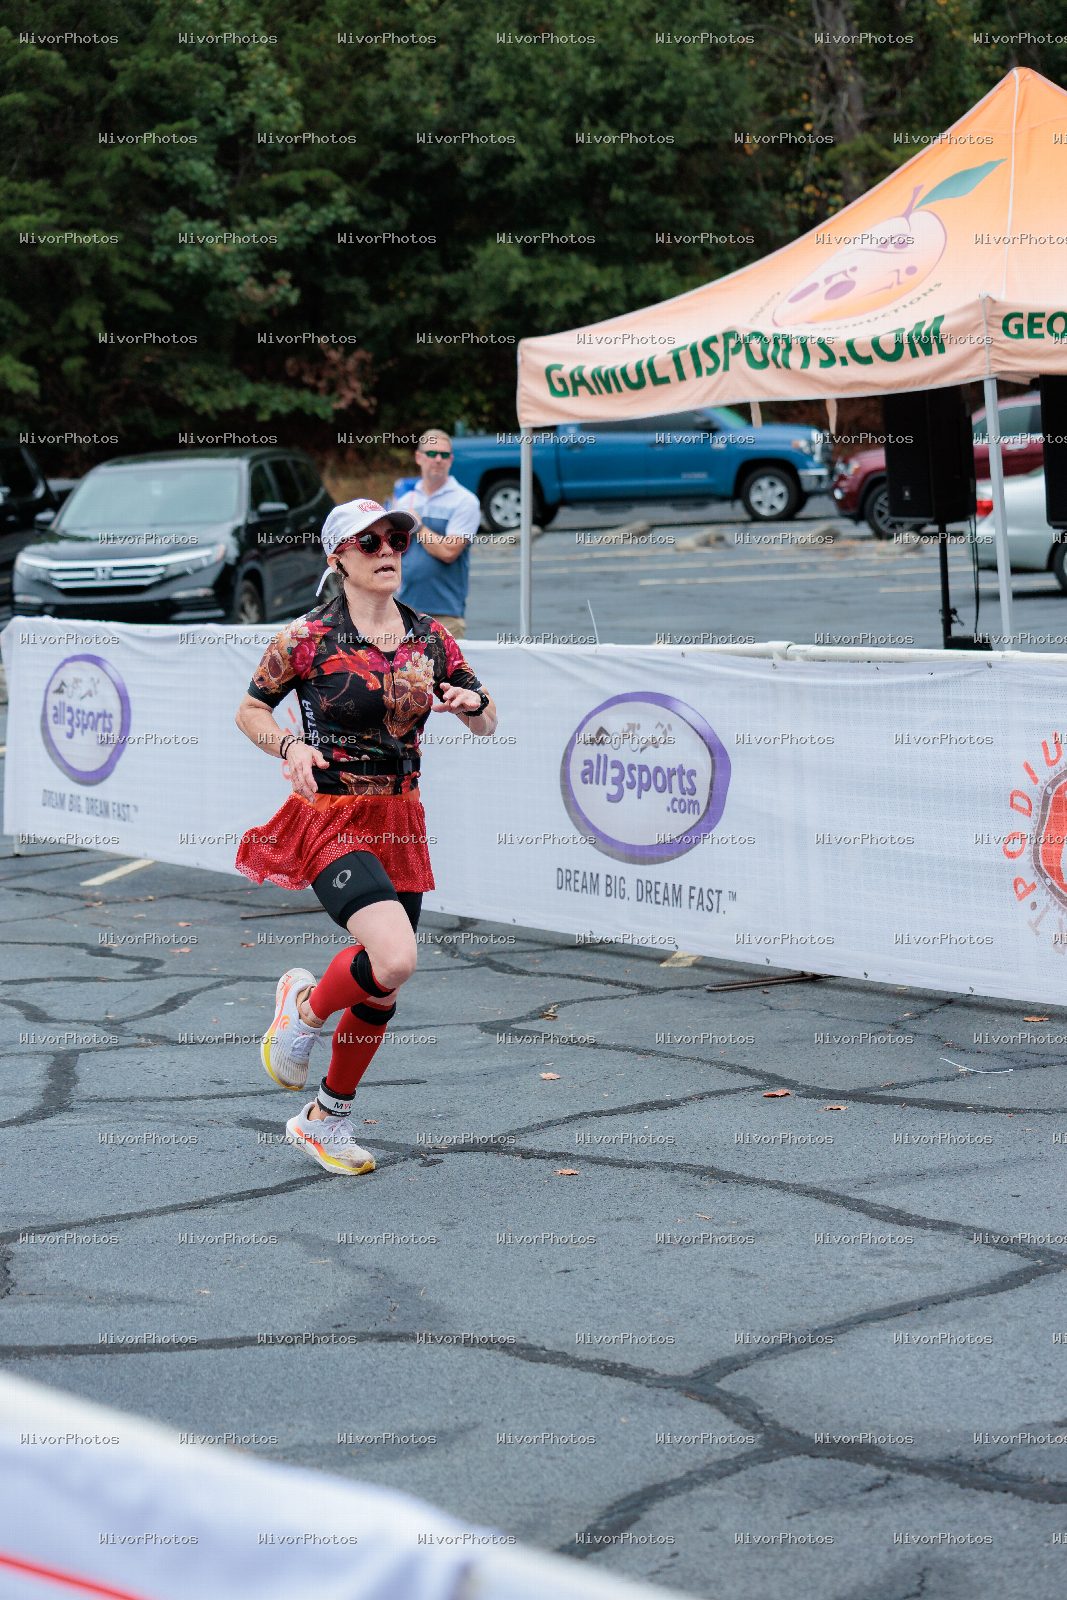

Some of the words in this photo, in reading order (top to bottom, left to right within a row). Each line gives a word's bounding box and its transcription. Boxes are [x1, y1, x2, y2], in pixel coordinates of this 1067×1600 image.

[51, 701, 113, 739] all3sports
[580, 752, 697, 803] all3sports
[666, 795, 701, 816] .com
[556, 867, 600, 897] DREAM
[605, 873, 631, 901] BIG.
[636, 878, 683, 909] DREAM
